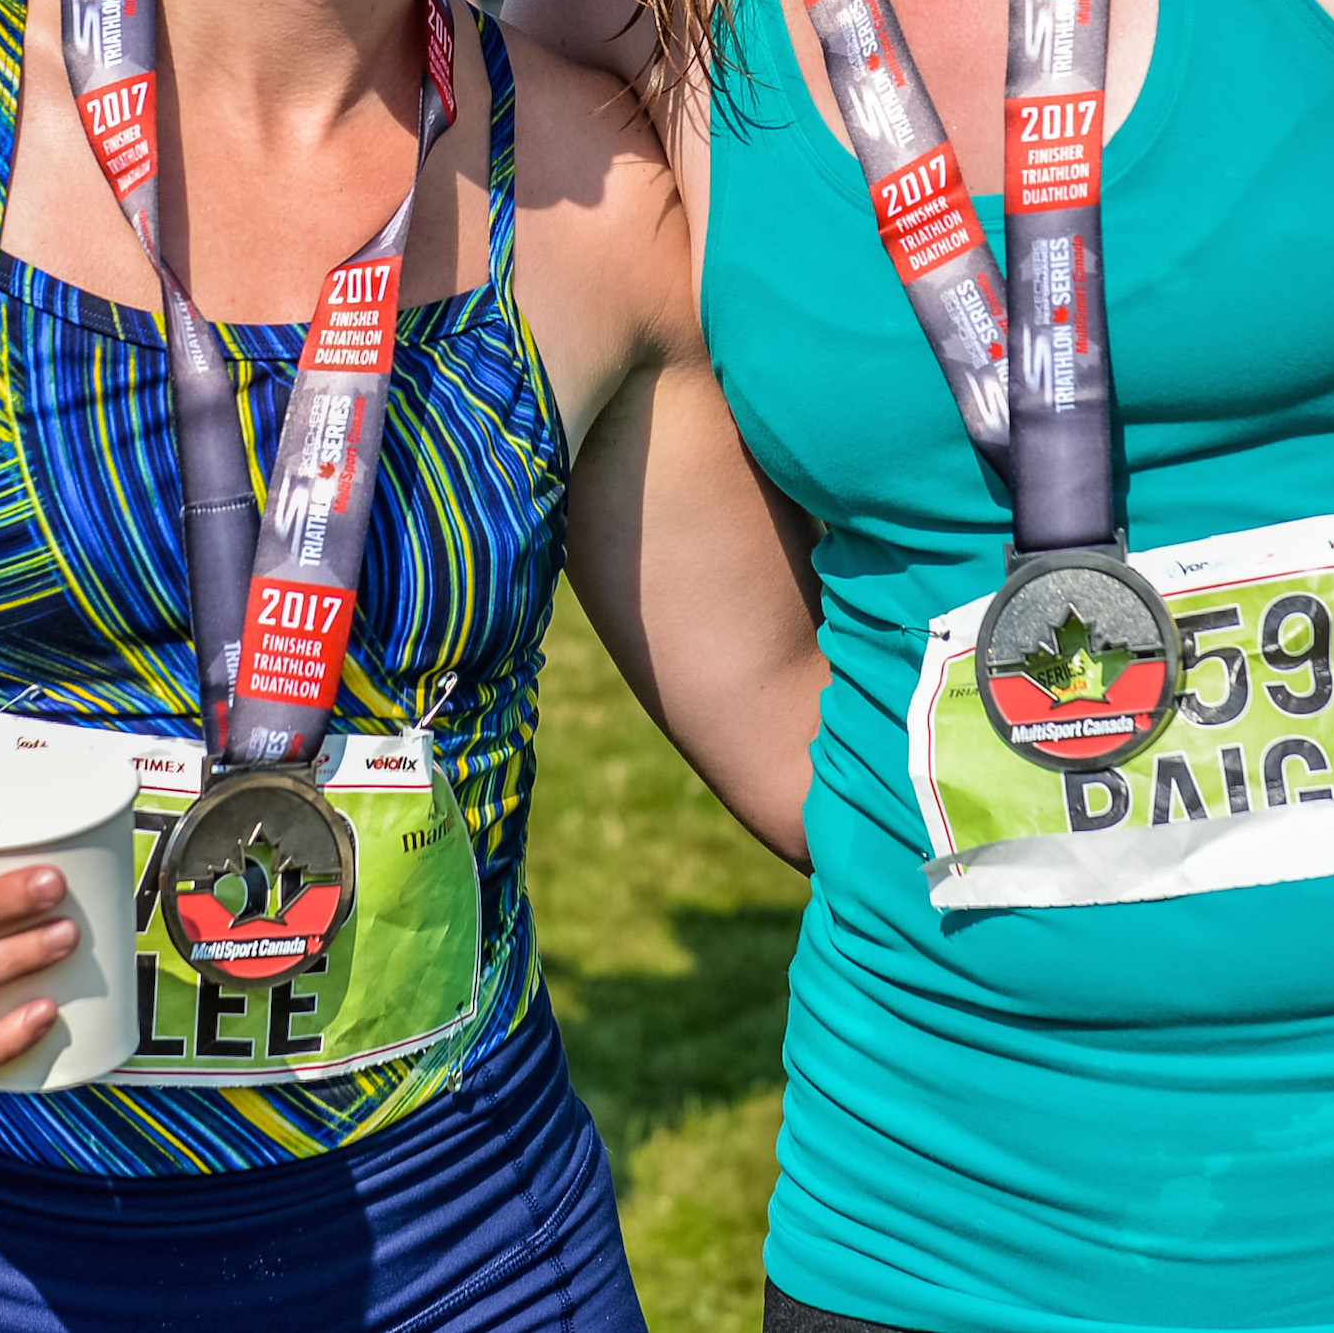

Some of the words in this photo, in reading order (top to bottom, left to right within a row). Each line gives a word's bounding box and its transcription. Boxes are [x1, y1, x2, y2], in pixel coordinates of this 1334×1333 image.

[87, 81, 148, 136] 2017
[871, 67, 916, 149] TRIATHLON
[1020, 100, 1097, 142] 2017
[103, 124, 142, 155] FINISHER
[1028, 144, 1084, 165] FINISHER
[881, 154, 947, 218] 2017
[1021, 162, 1090, 185] TRIATHLON
[1022, 183, 1088, 205] DUATHLON
[895, 195, 949, 233] FINISHER
[899, 210, 964, 253] TRIATHLON
[908, 227, 971, 271] DUATHLON
[327, 265, 391, 305] 2017
[1050, 237, 1072, 306] SERIES
[329, 310, 380, 327] FINISHER
[956, 279, 999, 345] SERIES
[314, 348, 379, 365] DUATHLON
[319, 330, 383, 346] TRIATHLON
[1053, 324, 1076, 414] TRIATHLON
[321, 394, 352, 463] SERIES
[258, 588, 343, 633] 2017
[262, 633, 323, 657] FINISHER
[1175, 592, 1334, 726] 59
[253, 653, 326, 679] TRIATHLON
[250, 674, 321, 699] DUATHLON
[1011, 721, 1082, 743] MultiSport
[1083, 715, 1134, 736] Canada
[132, 757, 185, 773] TIMEX
[190, 940, 257, 961] MultiSport
[258, 936, 306, 957] Canada
